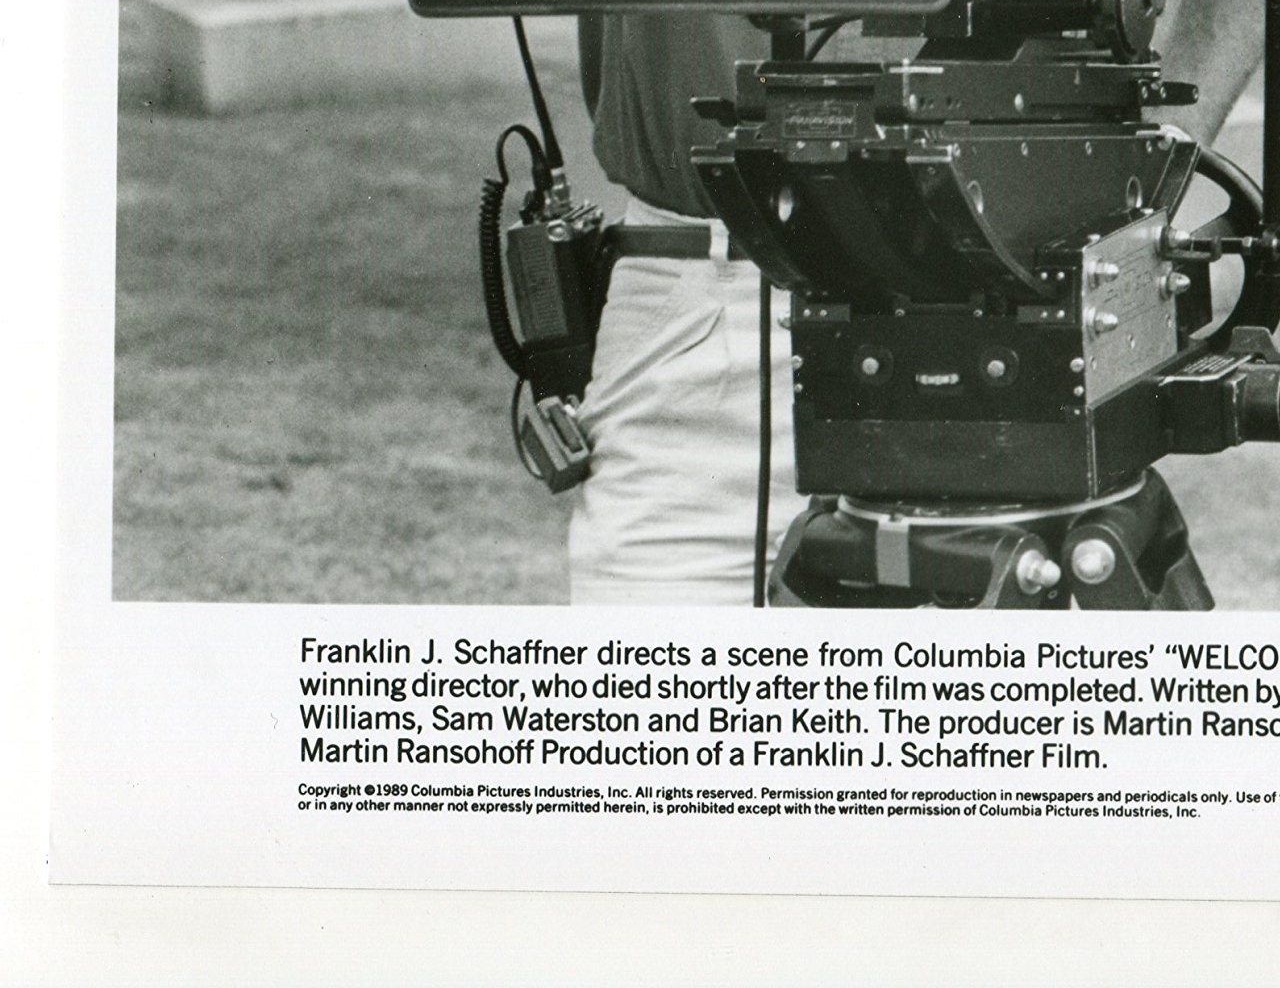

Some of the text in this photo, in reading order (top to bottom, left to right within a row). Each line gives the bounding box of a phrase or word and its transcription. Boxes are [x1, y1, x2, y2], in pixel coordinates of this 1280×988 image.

[301, 637, 411, 664] Franklin
[420, 638, 443, 665] J.
[454, 638, 589, 666] Schaffner
[597, 639, 691, 667] directs
[700, 647, 717, 667] a
[727, 647, 809, 667] scene
[818, 641, 883, 668] from
[894, 641, 1026, 669] Columbia
[299, 671, 407, 702] winning
[411, 671, 526, 702] director,
[531, 672, 588, 699] who
[592, 673, 651, 699] died
[657, 673, 751, 705] shortly
[755, 673, 821, 701] after
[823, 674, 869, 701] the
[873, 674, 927, 701] film
[932, 682, 985, 702] was
[990, 676, 1143, 707] completed.
[1150, 677, 1249, 704] Written
[299, 704, 423, 735] Williams,
[432, 704, 493, 731] Sam
[502, 705, 639, 733] Waterston
[647, 707, 699, 733] and
[709, 707, 782, 734] Brian
[792, 707, 869, 734] Keith.
[878, 708, 931, 735] The
[939, 709, 1065, 740] producer
[1073, 710, 1095, 736] is
[1103, 710, 1192, 737] Martin
[300, 737, 1108, 769] Martin Ransohoff Production of a Franklin J. Schaffner Film.
[297, 782, 362, 799] Copyright
[410, 783, 474, 798] Columbia
[477, 784, 532, 798] Pictures
[534, 785, 604, 800] Industries,
[607, 785, 632, 799] Inc.
[635, 786, 653, 799] All
[655, 786, 694, 801] rights
[696, 787, 757, 800] reserved.
[760, 786, 834, 800] Permission
[836, 788, 888, 803] granted
[890, 788, 909, 801] for
[911, 788, 997, 803] reproduction
[1000, 789, 1013, 801] in
[1015, 791, 1095, 804] newspapers
[1096, 790, 1122, 803] and
[1124, 790, 1199, 805] periodicals
[1200, 790, 1232, 806] only.
[1236, 791, 1261, 804] Use
[1263, 791, 1277, 804] of
[297, 798, 1201, 819] or in any other manner not expressly permitted herein, is prohibited except with the written permission of Columbia Pictures Industries, Inc.
